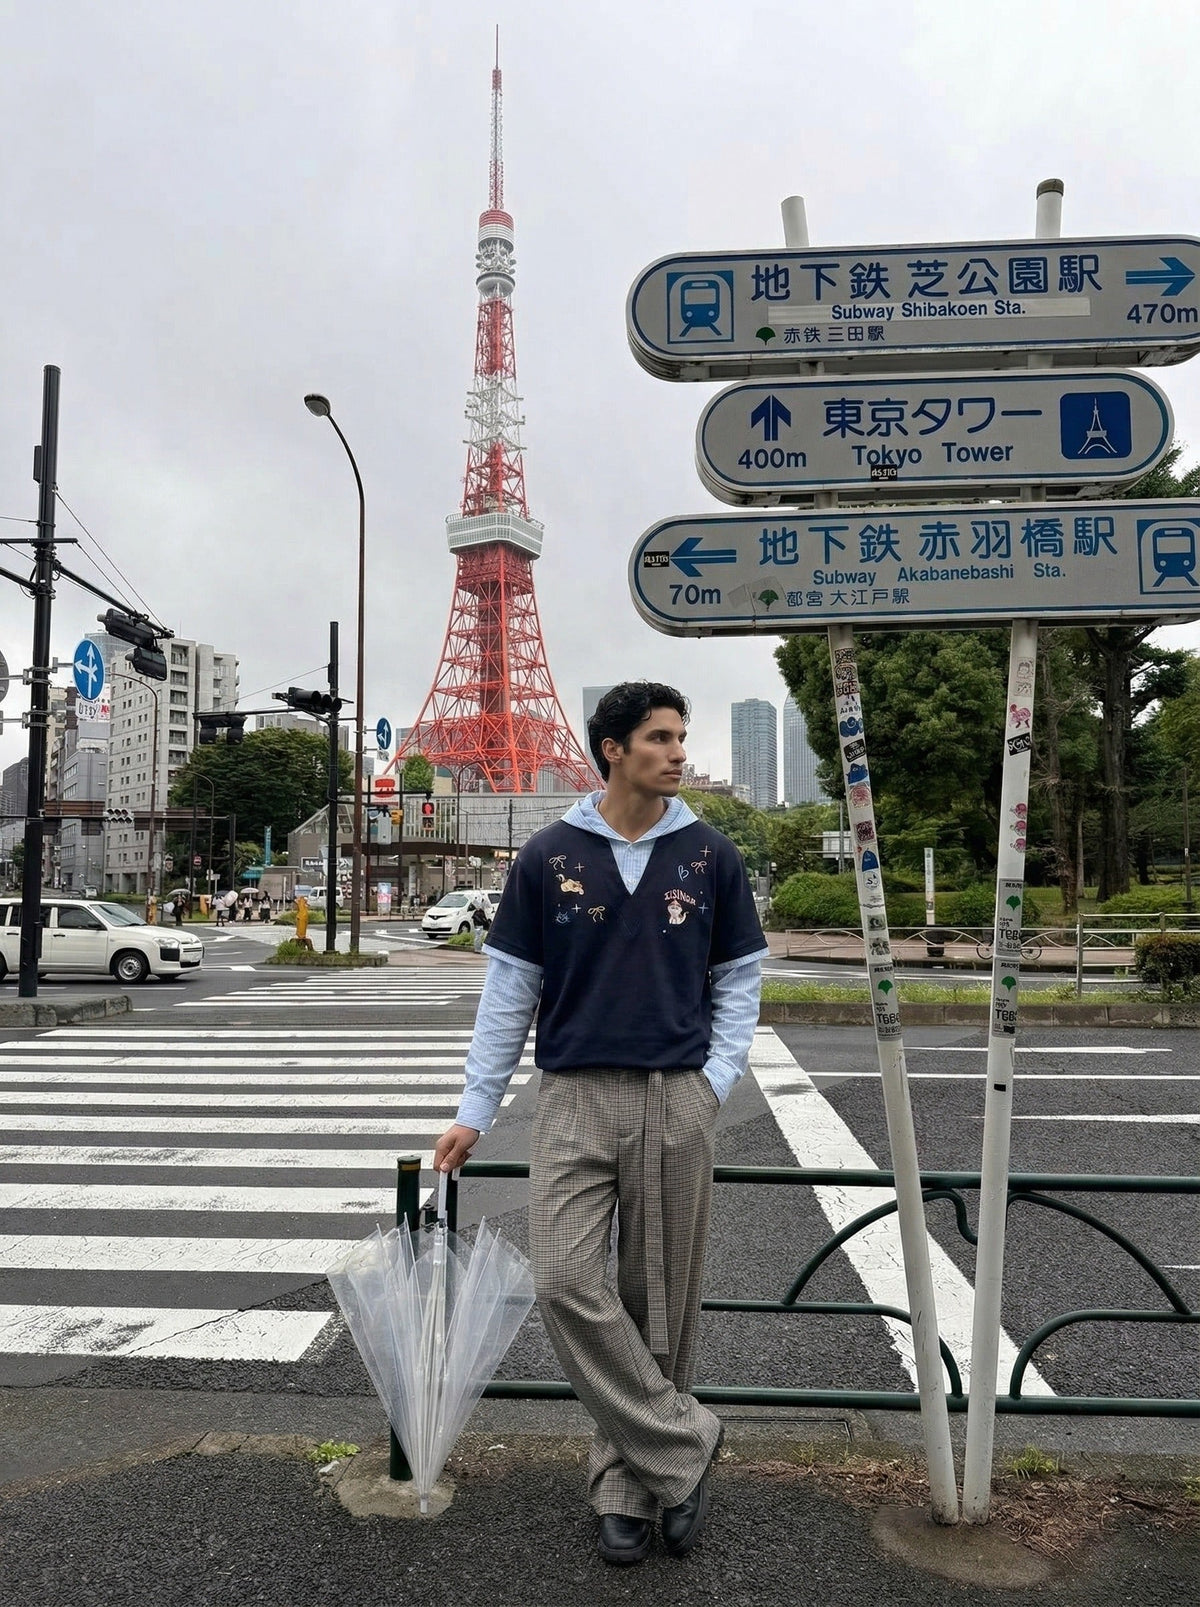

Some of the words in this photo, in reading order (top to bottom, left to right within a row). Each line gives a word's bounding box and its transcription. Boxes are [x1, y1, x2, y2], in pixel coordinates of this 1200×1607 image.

[831, 304, 895, 321] Subway
[901, 301, 988, 318] Shibakoen
[994, 299, 1026, 315] Sta.
[1126, 303, 1199, 324] 470m
[822, 397, 1043, 438] 東京タワー
[737, 447, 807, 469] 400m
[851, 444, 922, 469] Tokyo
[941, 442, 1014, 463] Tower
[813, 569, 877, 586] Subway
[897, 564, 1014, 582] Akabanebashi
[1033, 562, 1066, 578] Sta.
[669, 584, 721, 605] 70m
